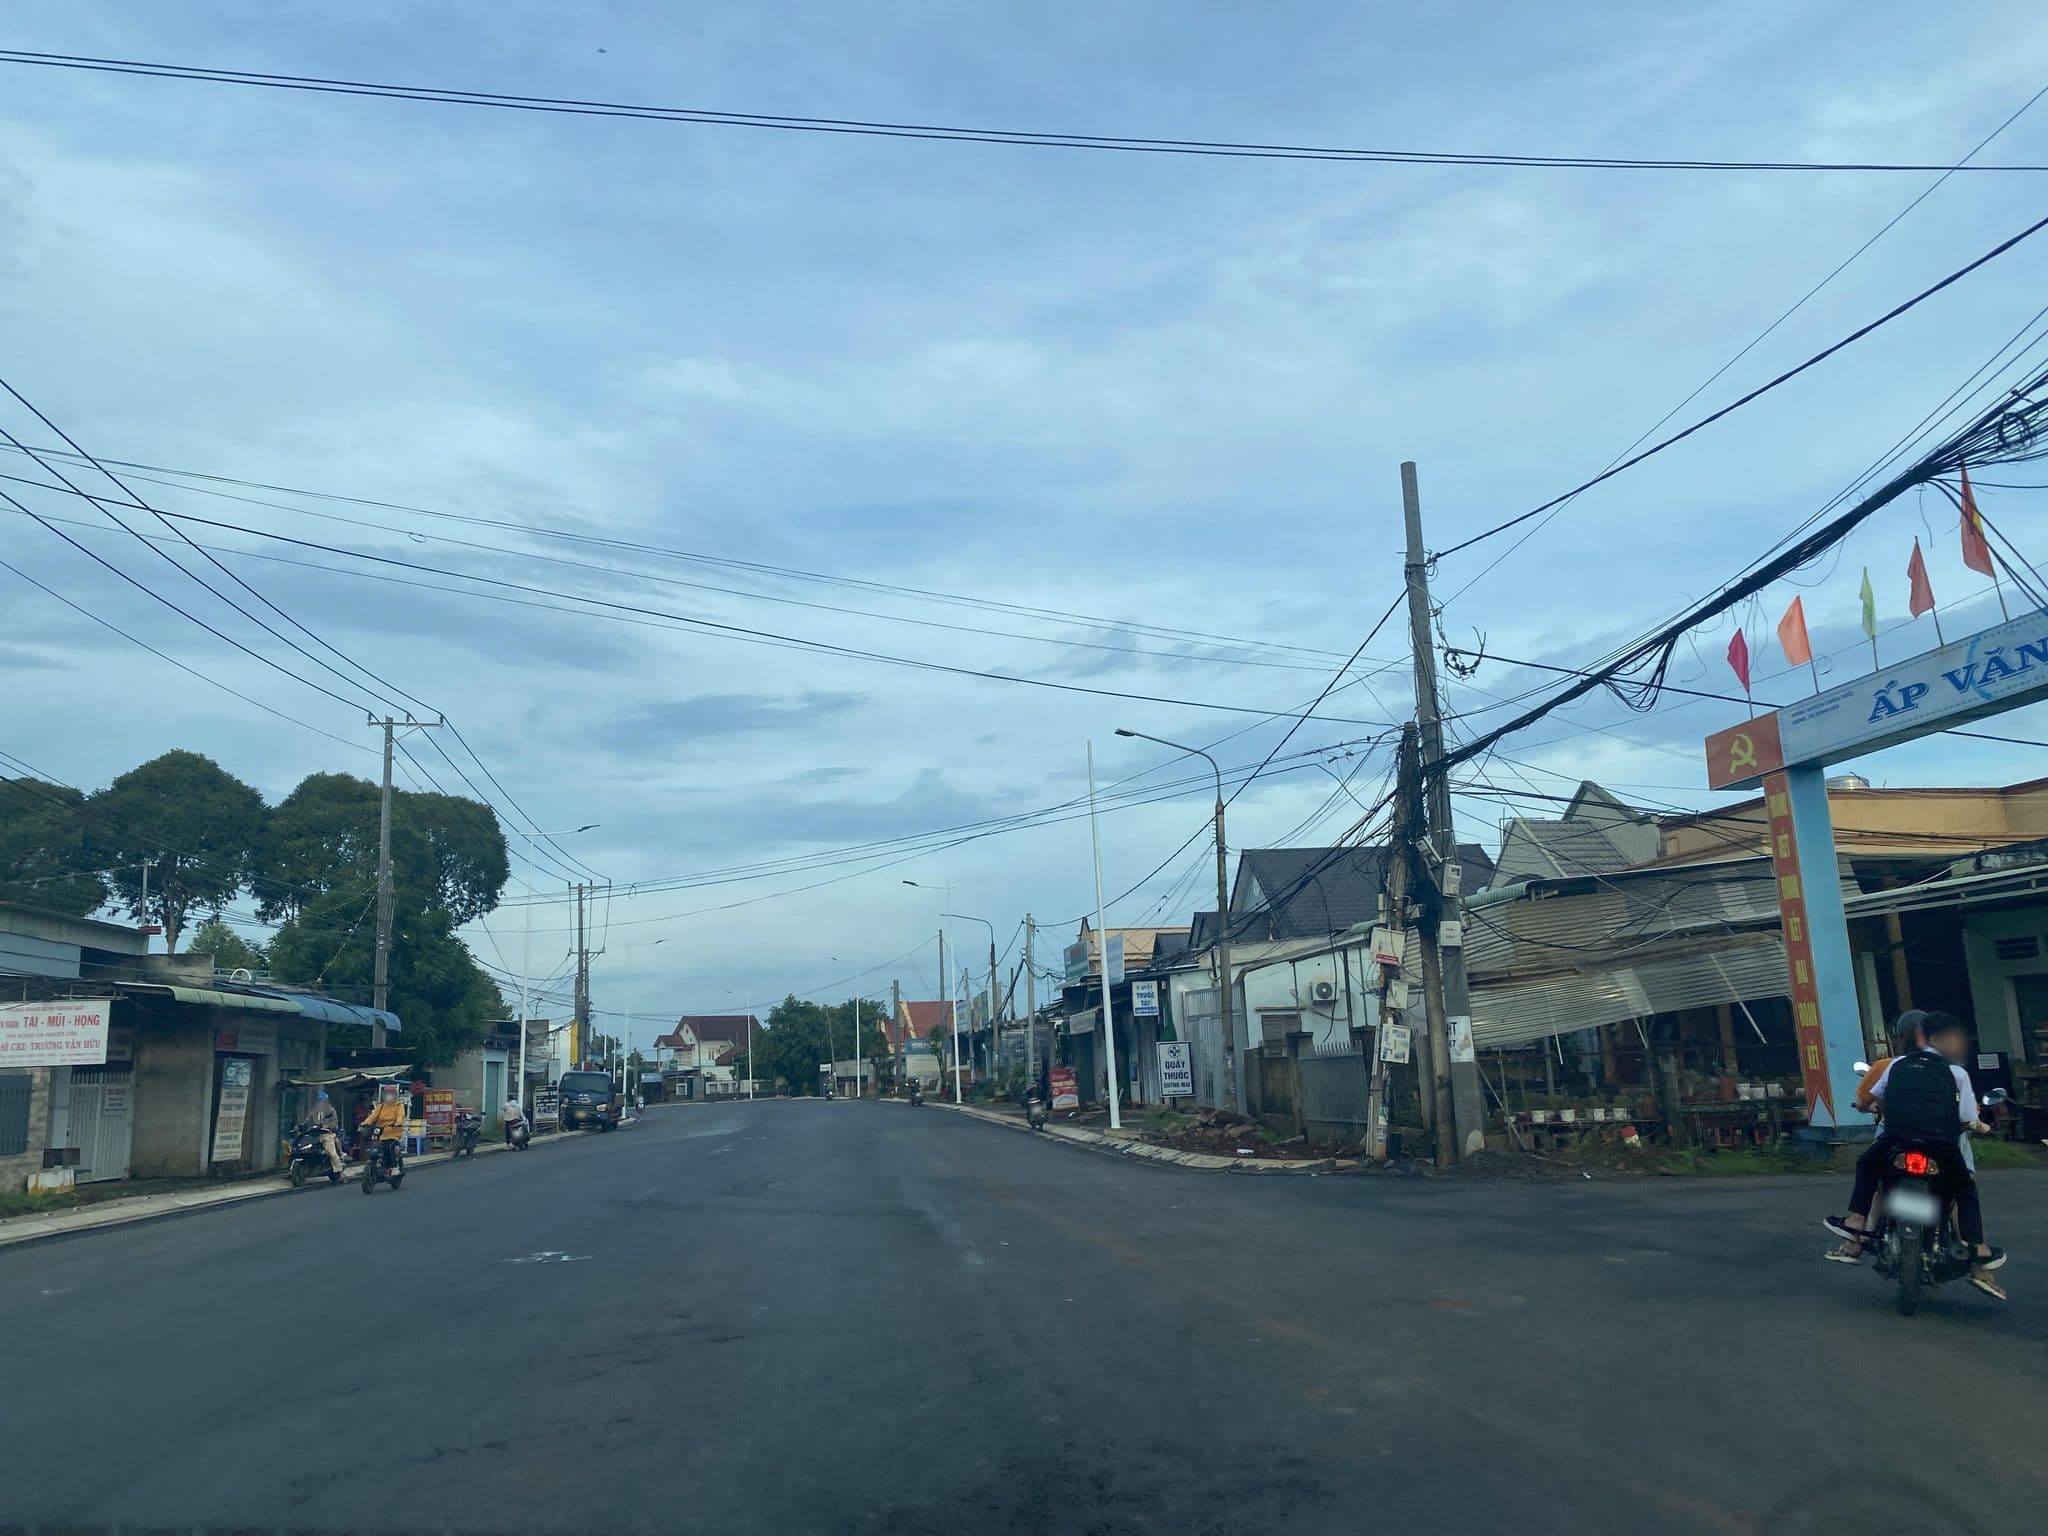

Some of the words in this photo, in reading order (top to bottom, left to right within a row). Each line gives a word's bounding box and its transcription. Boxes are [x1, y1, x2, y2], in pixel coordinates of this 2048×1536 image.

[1867, 679, 1930, 724] ẤP
[1941, 636, 2048, 695] VĂN
[24, 1016, 39, 1028] TAI
[47, 1013, 66, 1027] MŨI
[74, 1015, 100, 1028] HỌNG
